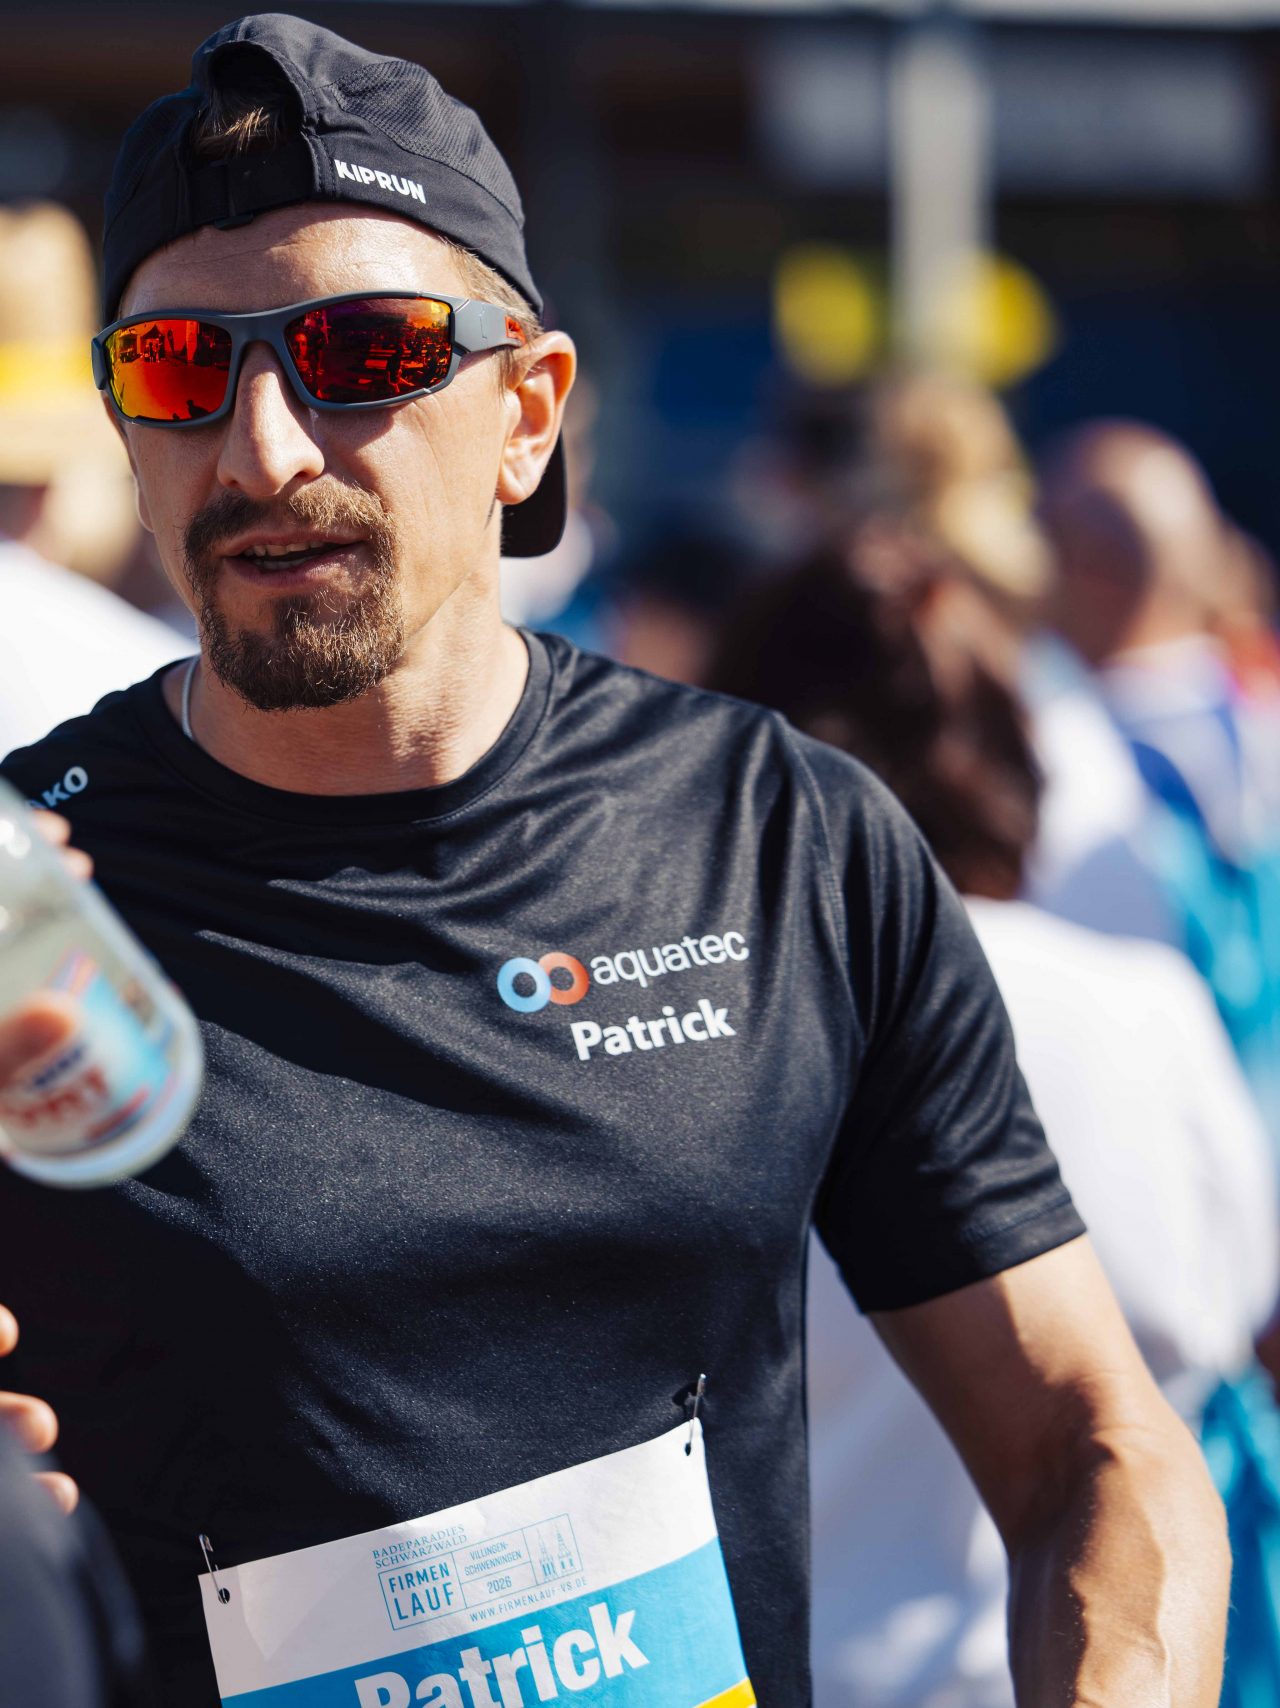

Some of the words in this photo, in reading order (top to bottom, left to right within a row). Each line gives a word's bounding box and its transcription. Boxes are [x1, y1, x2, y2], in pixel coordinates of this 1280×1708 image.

[334, 159, 426, 204] KIPRUN
[28, 766, 89, 808] KO
[590, 931, 750, 988] aquatec
[570, 999, 737, 1061] Patrick
[372, 1524, 465, 1559] BADEPARADIES
[375, 1534, 468, 1569] SCHWARZWALD
[470, 1541, 509, 1561] VILLINGEN-
[388, 1562, 449, 1593] FIRMEN
[464, 1550, 522, 1576] SCHWENNINGEN
[394, 1582, 454, 1620] LAUF
[470, 1576, 587, 1622] WWW.FIRMENLAUF-VS.DE
[487, 1576, 512, 1594] 2026
